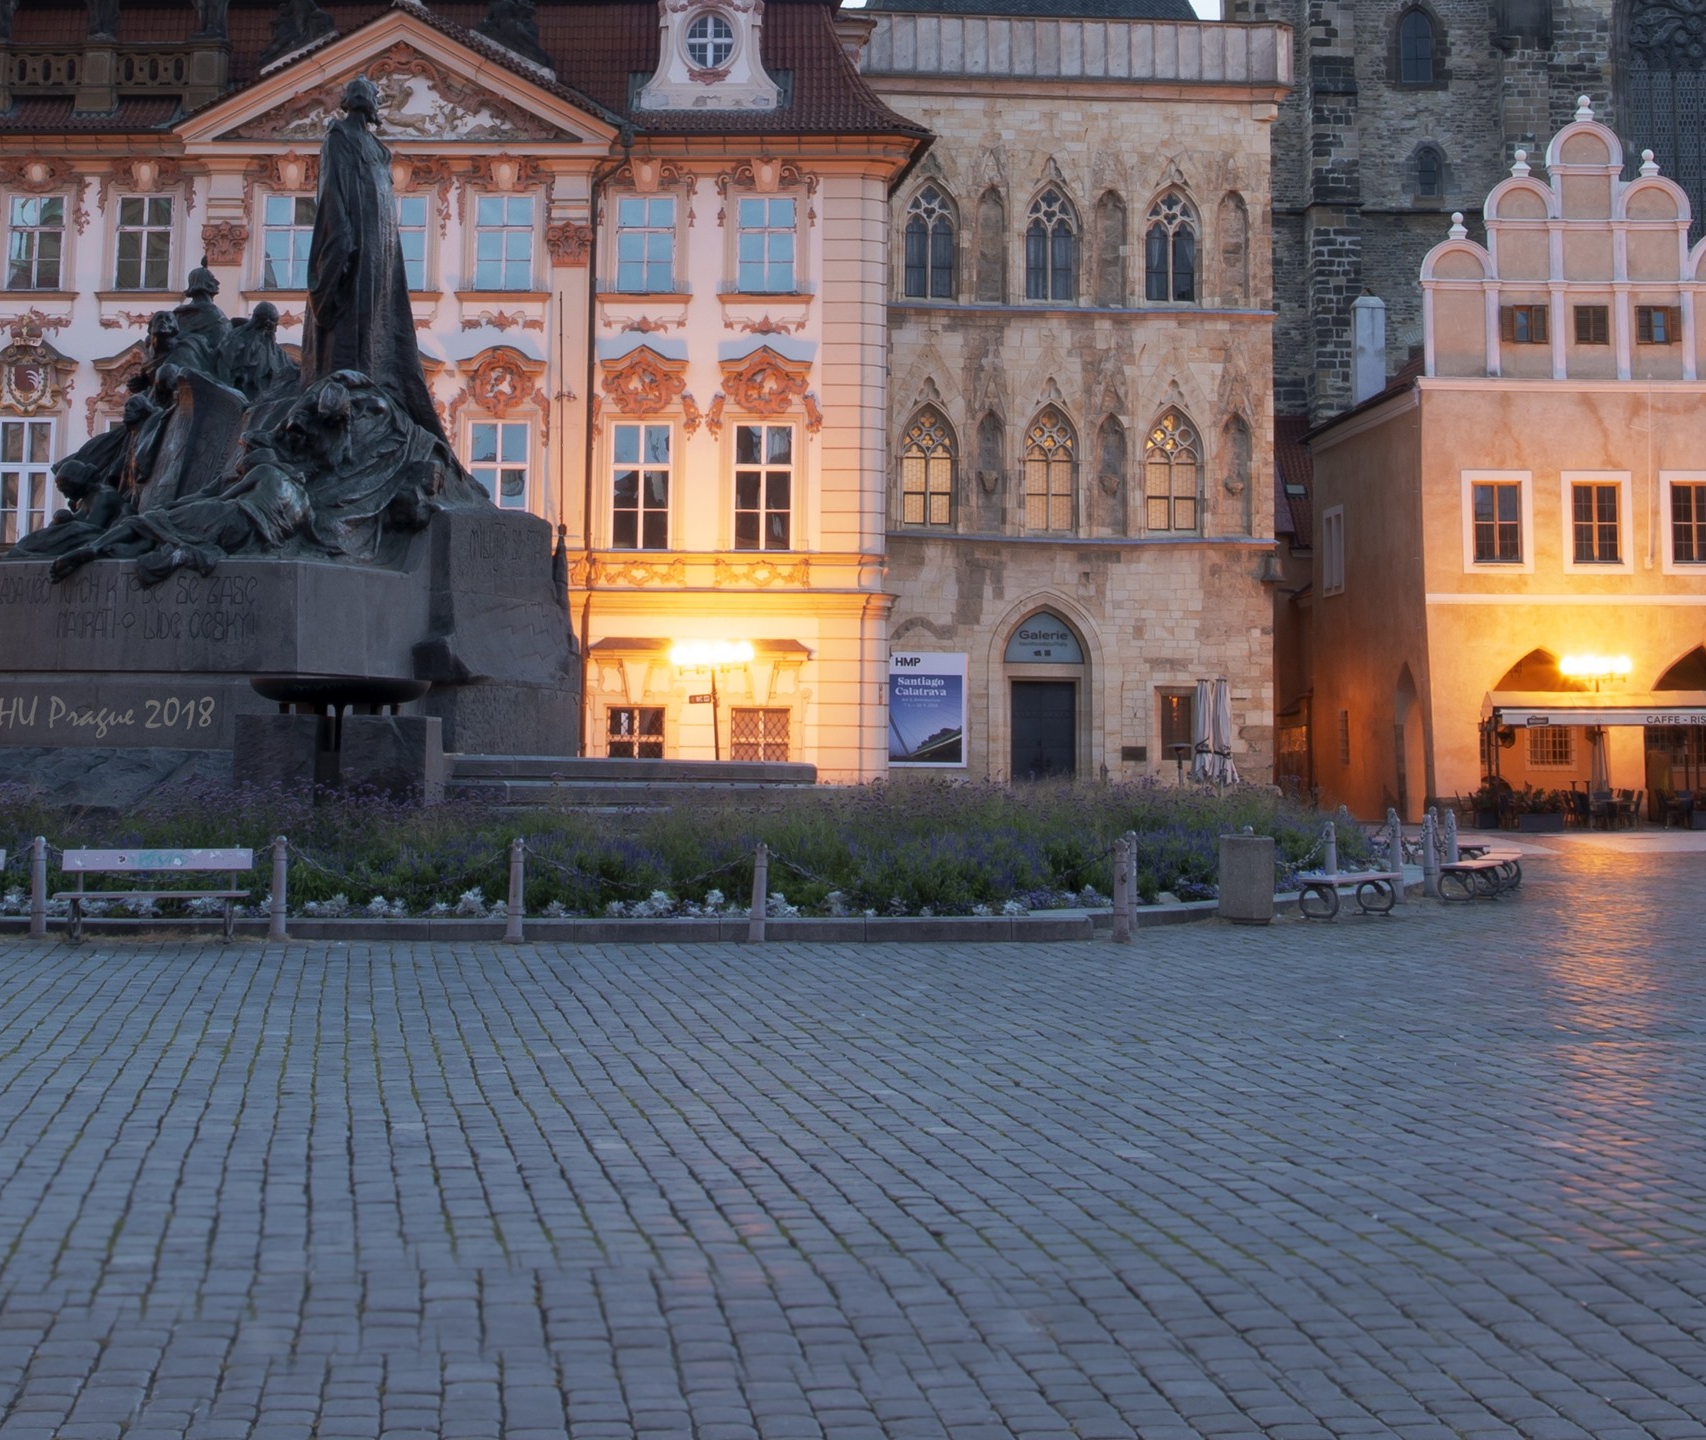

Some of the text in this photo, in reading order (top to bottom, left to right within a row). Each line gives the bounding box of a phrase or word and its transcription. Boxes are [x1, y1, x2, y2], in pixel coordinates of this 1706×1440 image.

[175, 575, 198, 604] SE
[207, 575, 257, 605] ZASE
[1018, 629, 1068, 641] Galerie
[895, 657, 921, 667] HMP
[897, 676, 945, 687] Santiago
[895, 687, 947, 696] Calatrava
[1646, 715, 1681, 724] CAFFE
